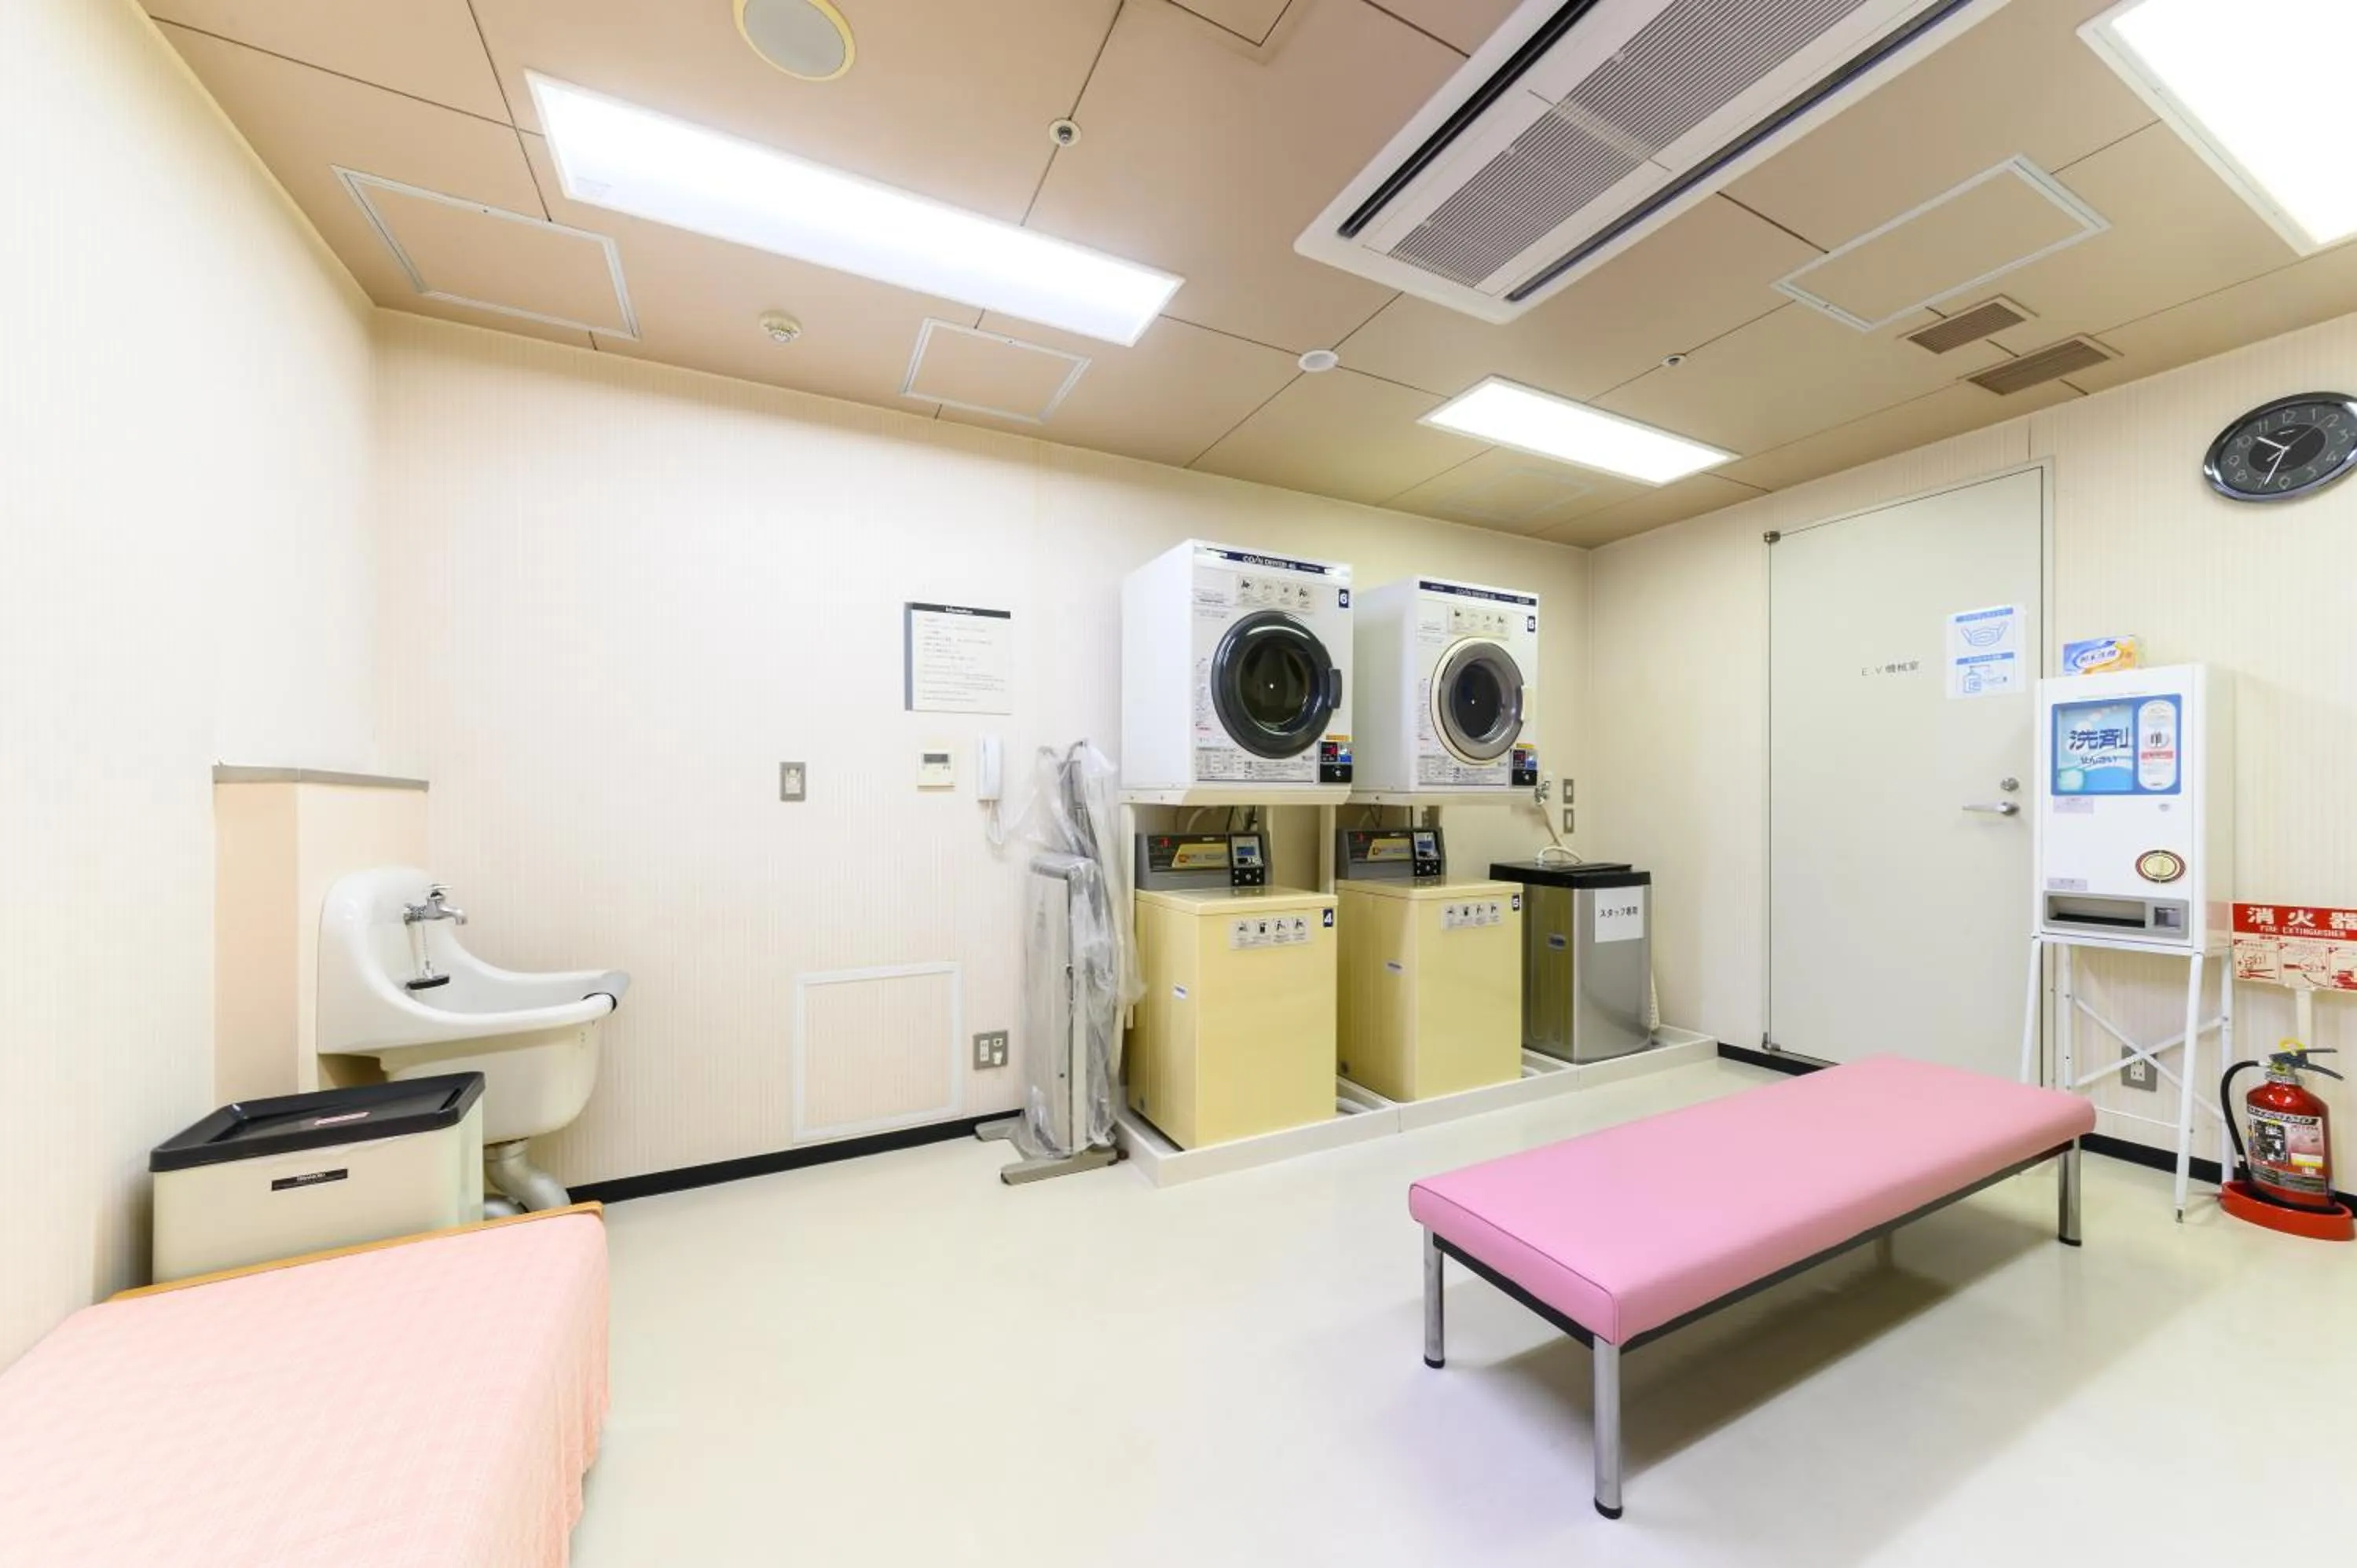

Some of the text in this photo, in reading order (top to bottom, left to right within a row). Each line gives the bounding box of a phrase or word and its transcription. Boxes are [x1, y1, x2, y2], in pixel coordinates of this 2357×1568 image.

[2282, 409, 2296, 423] 12
[2311, 408, 2316, 421] 1
[2327, 413, 2339, 427] 2
[2257, 419, 2269, 433] 11
[2326, 450, 2337, 462] 4
[2069, 727, 2128, 750] 洗剤
[1325, 912, 1332, 923] 4
[2247, 907, 2357, 929] 消火器
